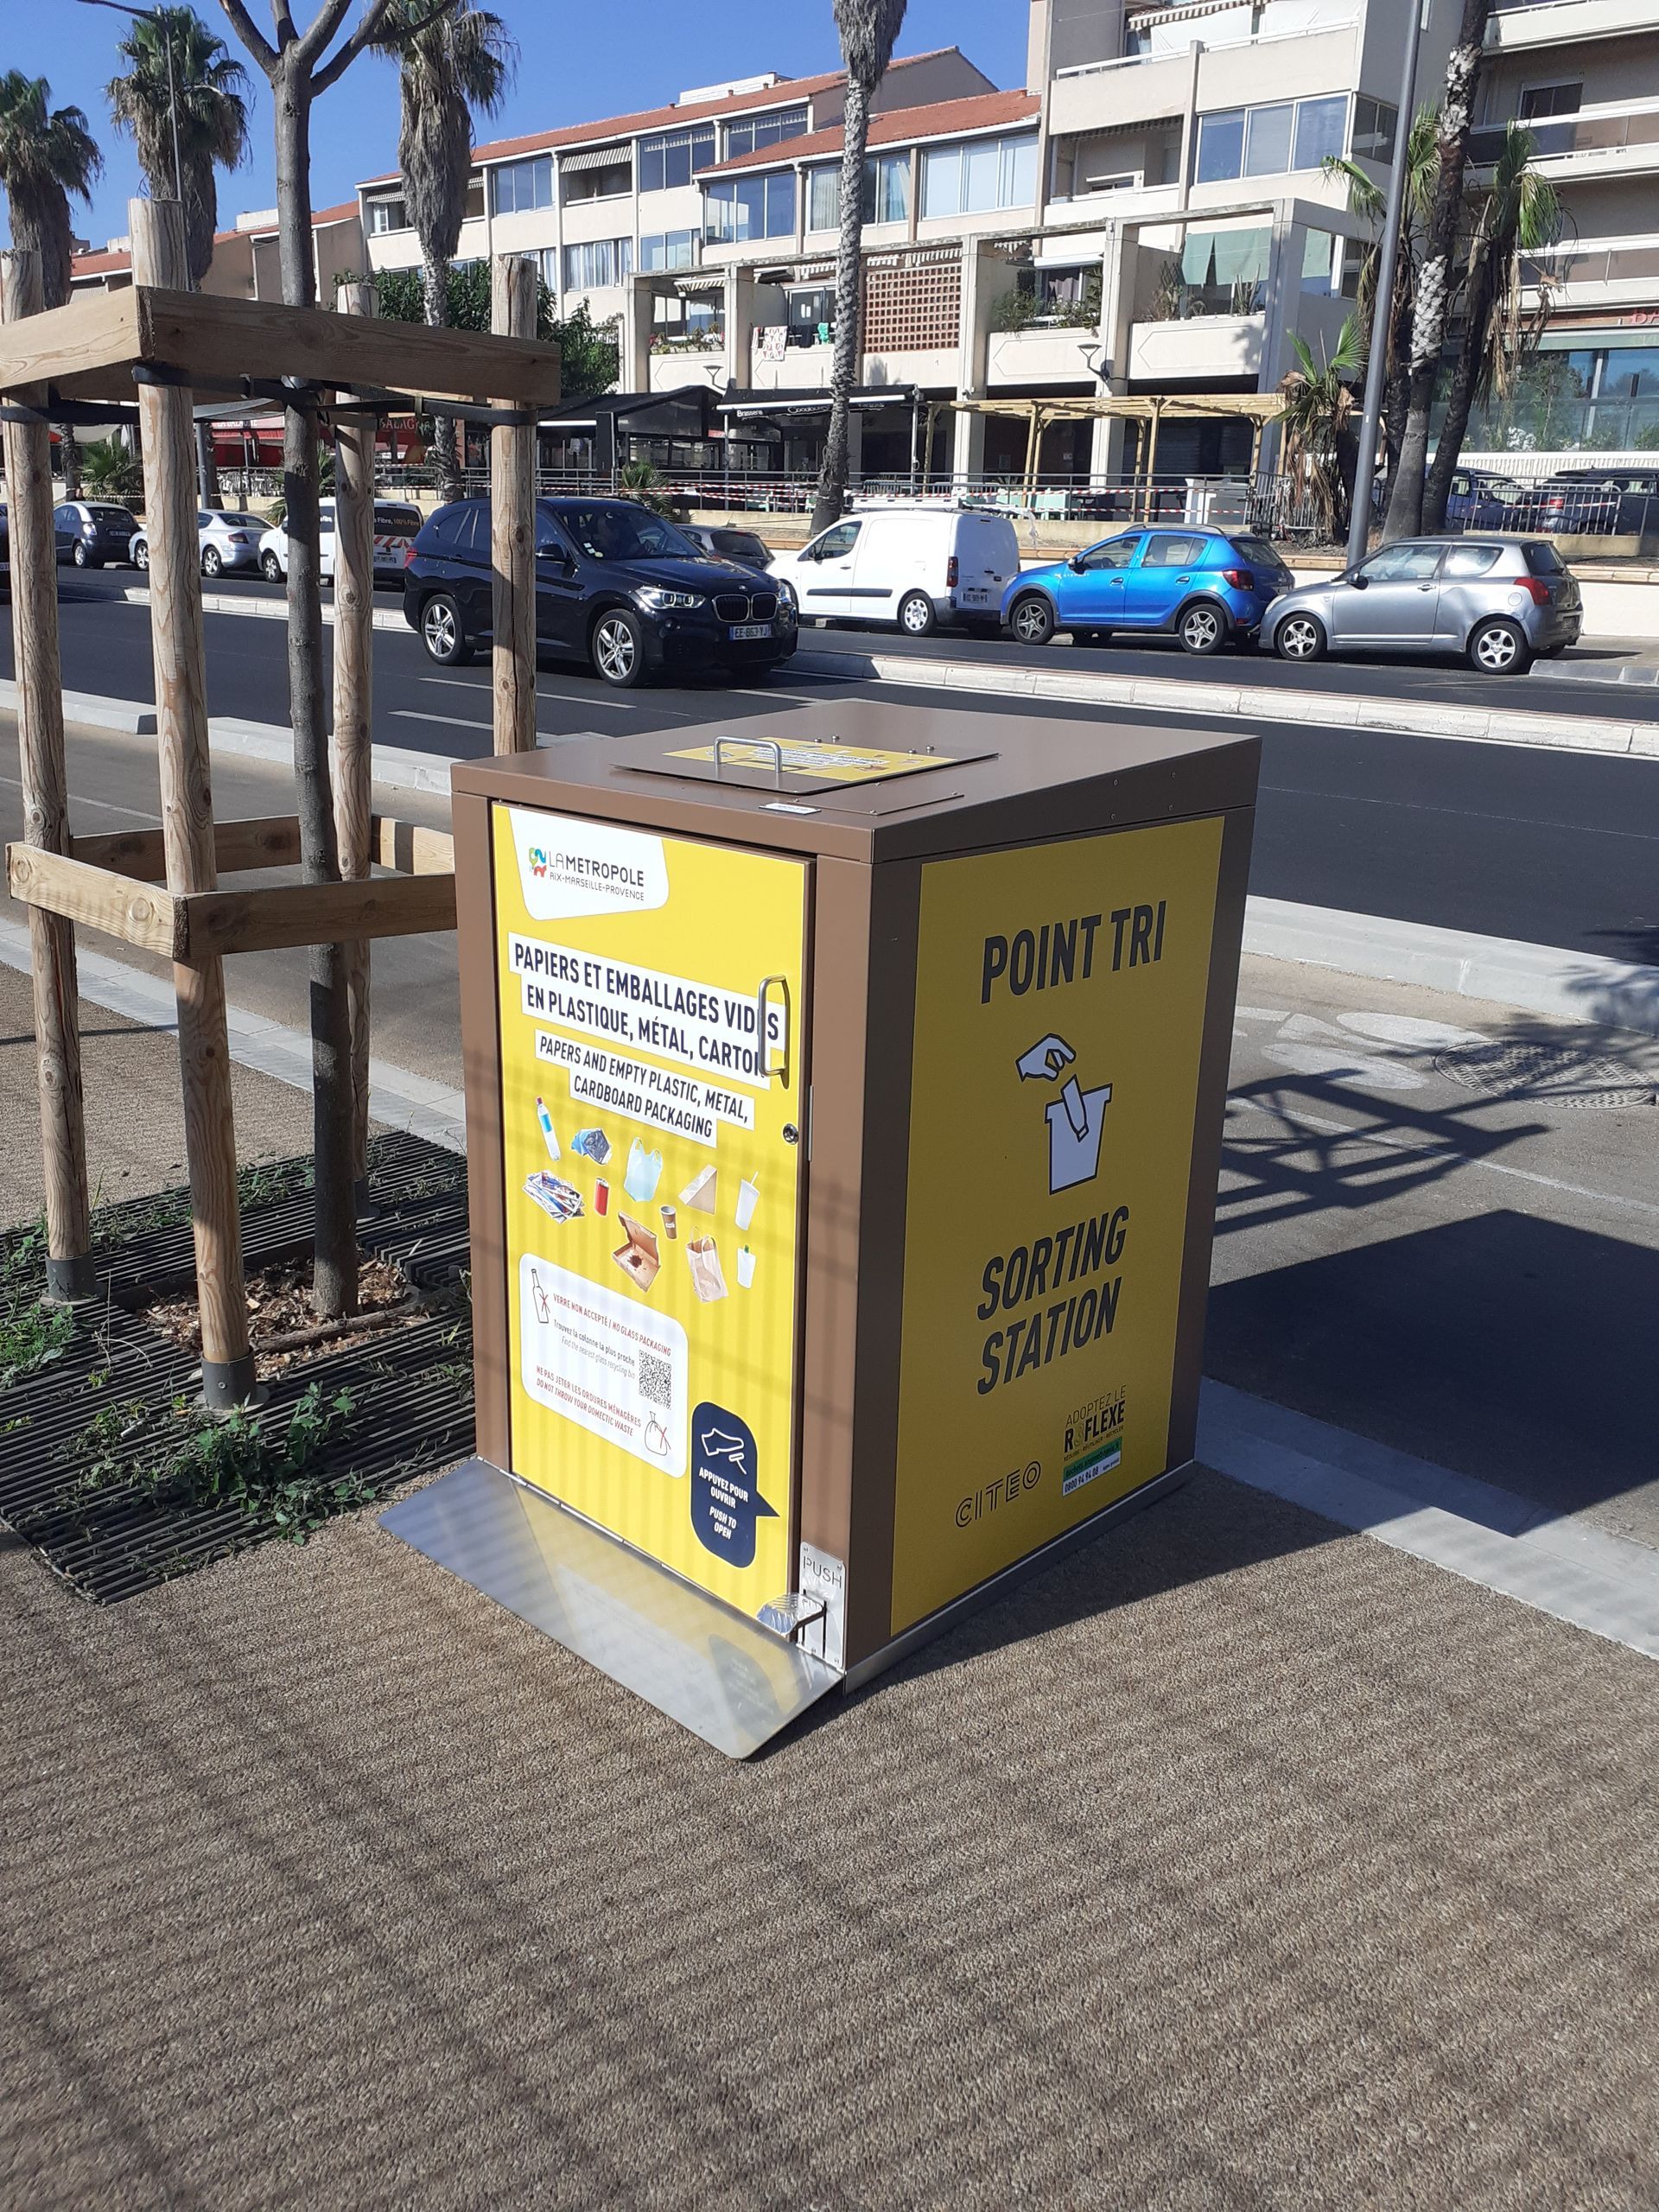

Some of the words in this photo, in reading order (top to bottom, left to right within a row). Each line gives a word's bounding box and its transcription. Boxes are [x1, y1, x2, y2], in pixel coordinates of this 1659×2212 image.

[981, 912, 1103, 1004] POINT
[1109, 899, 1167, 972] TRI
[515, 943, 580, 983] PAPIERS
[584, 962, 602, 990] ET
[607, 967, 719, 1023] EMBALLAGES
[724, 1000, 779, 1040] VIDS
[527, 984, 544, 1010] EN
[549, 990, 633, 1042] PLASTIQUE,
[639, 1016, 694, 1060] MÉTAL,
[540, 1036, 582, 1065] PAPERS
[583, 1050, 607, 1072] AND
[609, 1058, 647, 1085] EMPTY
[649, 1071, 701, 1108] PLASTIC,
[704, 1089, 748, 1124] METAL,
[574, 1075, 642, 1113] CARDBOARD
[645, 1098, 713, 1138] PACKAGING
[976, 1205, 1130, 1321] SORTING
[553, 1293, 570, 1309] VERRE
[571, 1300, 583, 1314] NON
[583, 1307, 608, 1328] ACCEPTÉ
[613, 1321, 620, 1332] NO
[620, 1325, 639, 1341] GLASS
[639, 1334, 671, 1357] PACKAGING
[554, 1319, 572, 1336] Trouvez
[579, 1333, 598, 1348] colonne
[606, 1345, 617, 1357] plus
[617, 1352, 635, 1367] proche
[976, 1275, 1122, 1395] STATION
[537, 1365, 543, 1376] NE
[544, 1369, 554, 1381] PAS
[556, 1375, 571, 1390] JETER
[571, 1383, 582, 1395] LES
[582, 1389, 607, 1409] ORDURES
[537, 1377, 543, 1389] DO
[544, 1381, 555, 1394] NOT
[555, 1386, 574, 1404] THROW
[574, 1397, 588, 1412] YOUR
[614, 1419, 634, 1436] WASTE
[1065, 1391, 1112, 1427] ADOPTEZ
[1114, 1384, 1127, 1402] LE
[699, 1466, 729, 1491] APPUYEZ
[729, 1483, 749, 1503] POUR
[710, 1486, 736, 1510] OUVRIR
[955, 1460, 1041, 1529] CITEO
[709, 1506, 728, 1524] PUSH
[728, 1516, 737, 1529] TO
[714, 1522, 732, 1540] OPEN
[803, 1555, 842, 1590] PUSH
